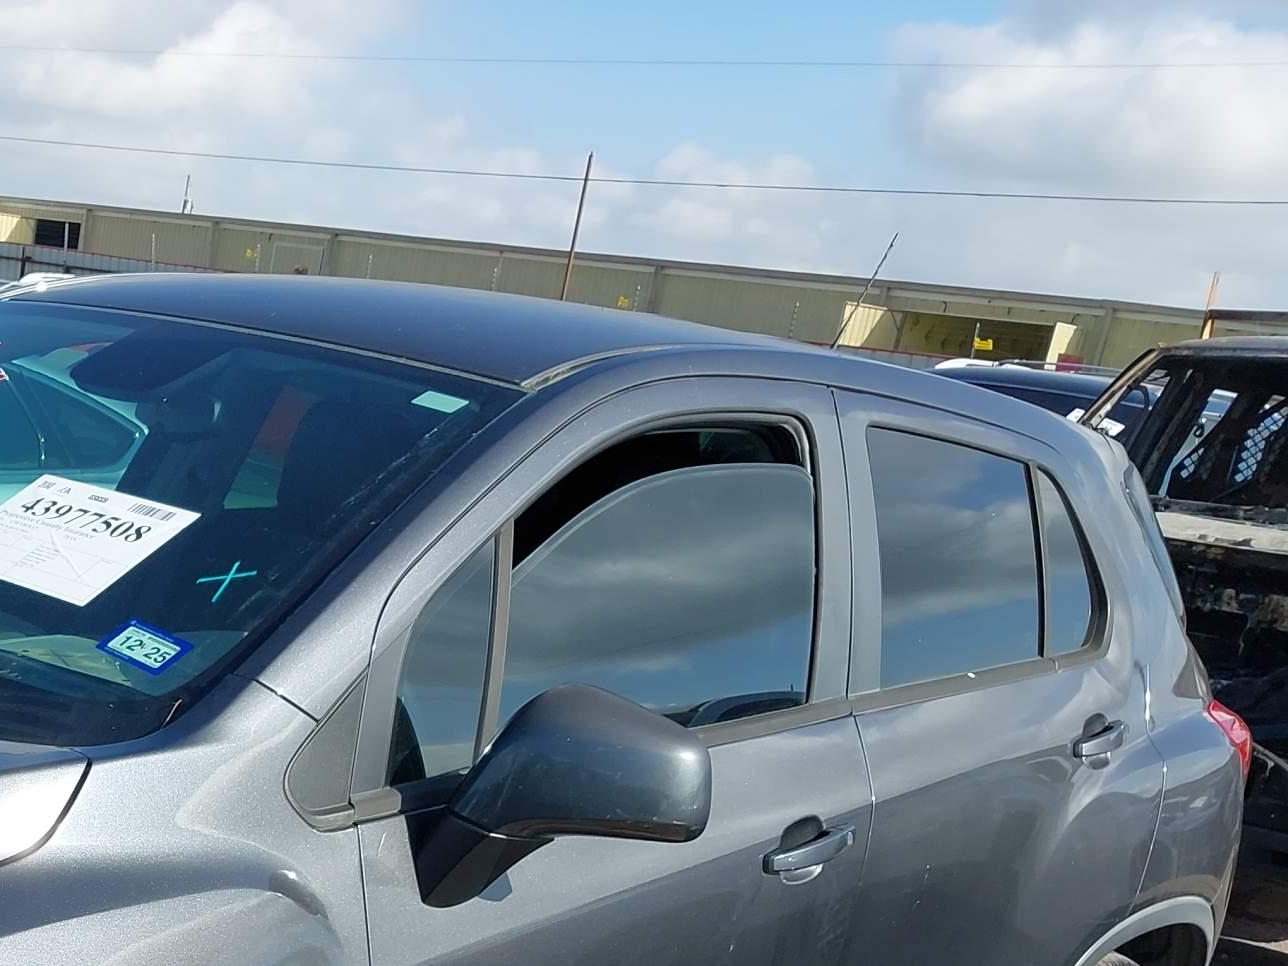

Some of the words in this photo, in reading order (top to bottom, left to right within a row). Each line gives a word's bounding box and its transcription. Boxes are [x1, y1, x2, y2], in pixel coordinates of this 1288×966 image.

[20, 496, 152, 543] 43977508
[119, 635, 144, 652] 12
[142, 646, 172, 664] 25
